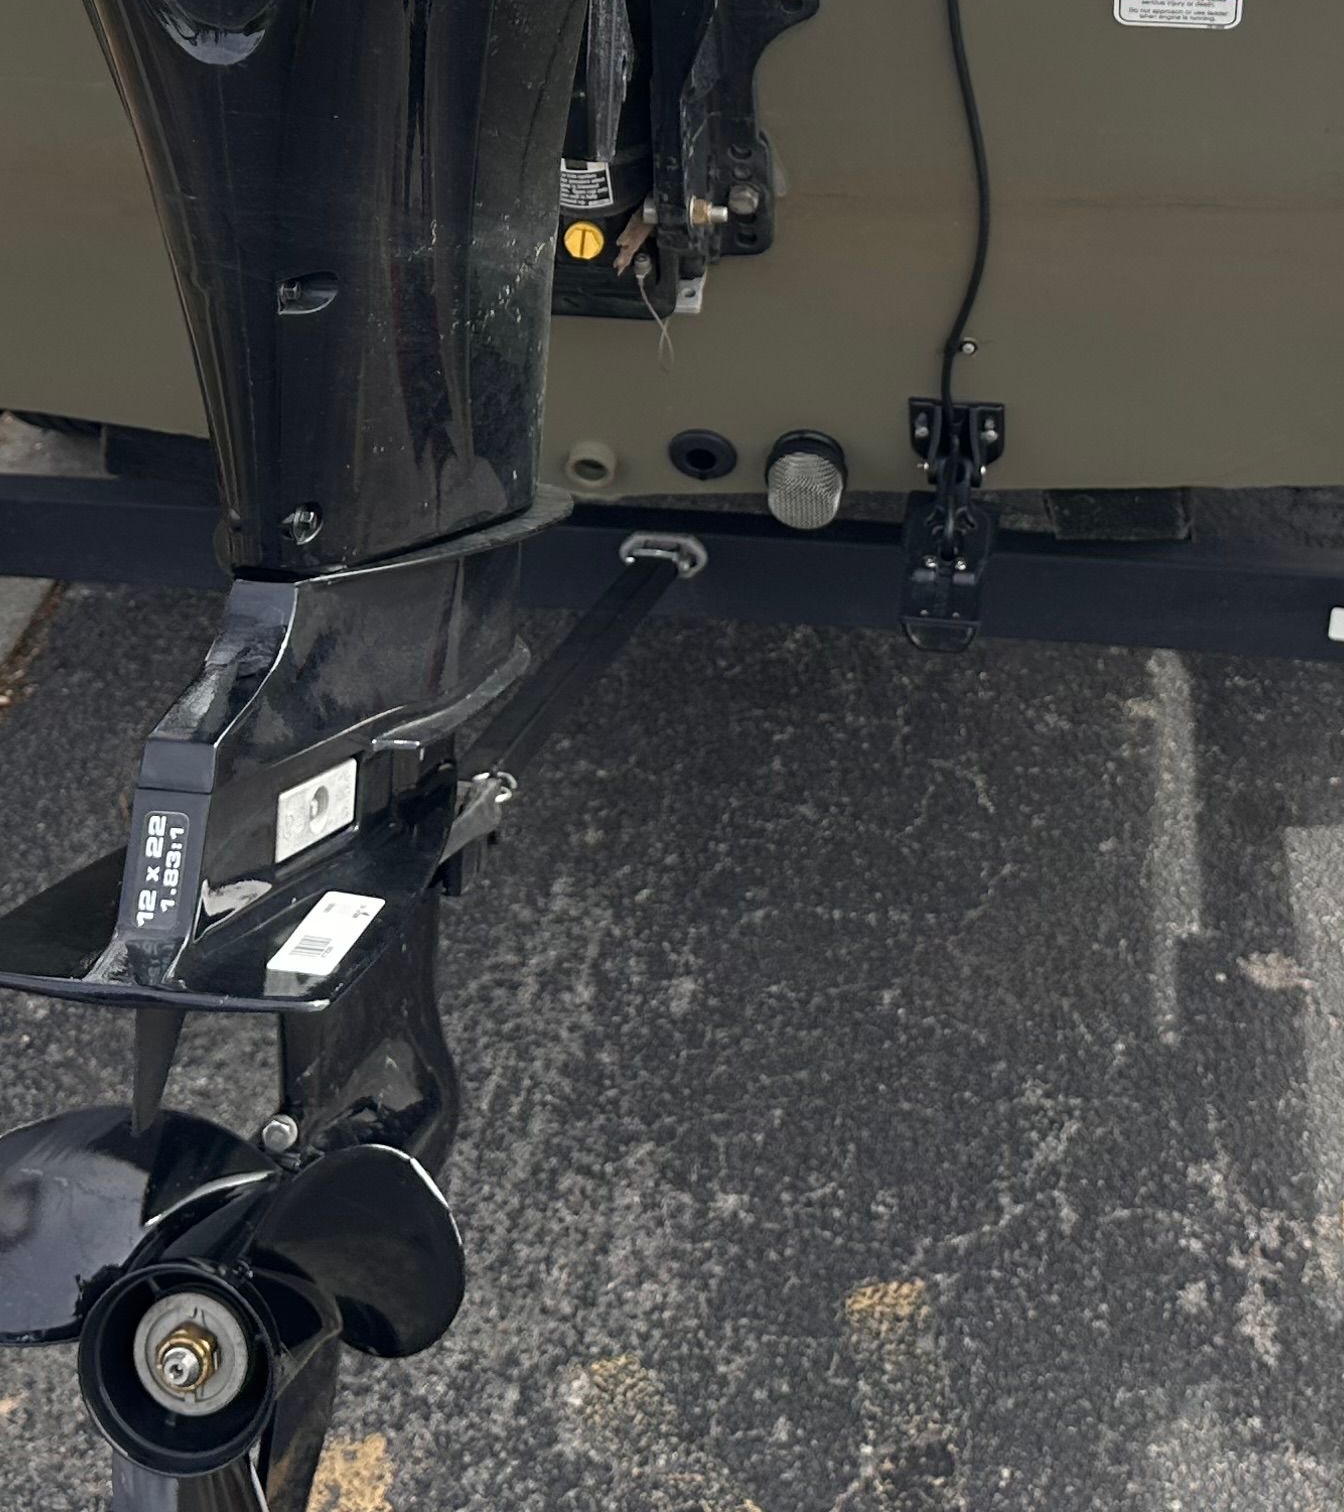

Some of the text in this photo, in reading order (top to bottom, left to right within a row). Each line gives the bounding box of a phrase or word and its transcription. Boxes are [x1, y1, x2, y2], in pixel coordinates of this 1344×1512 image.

[137, 815, 167, 927] 12 x 22
[159, 827, 185, 913] 1.83:1
